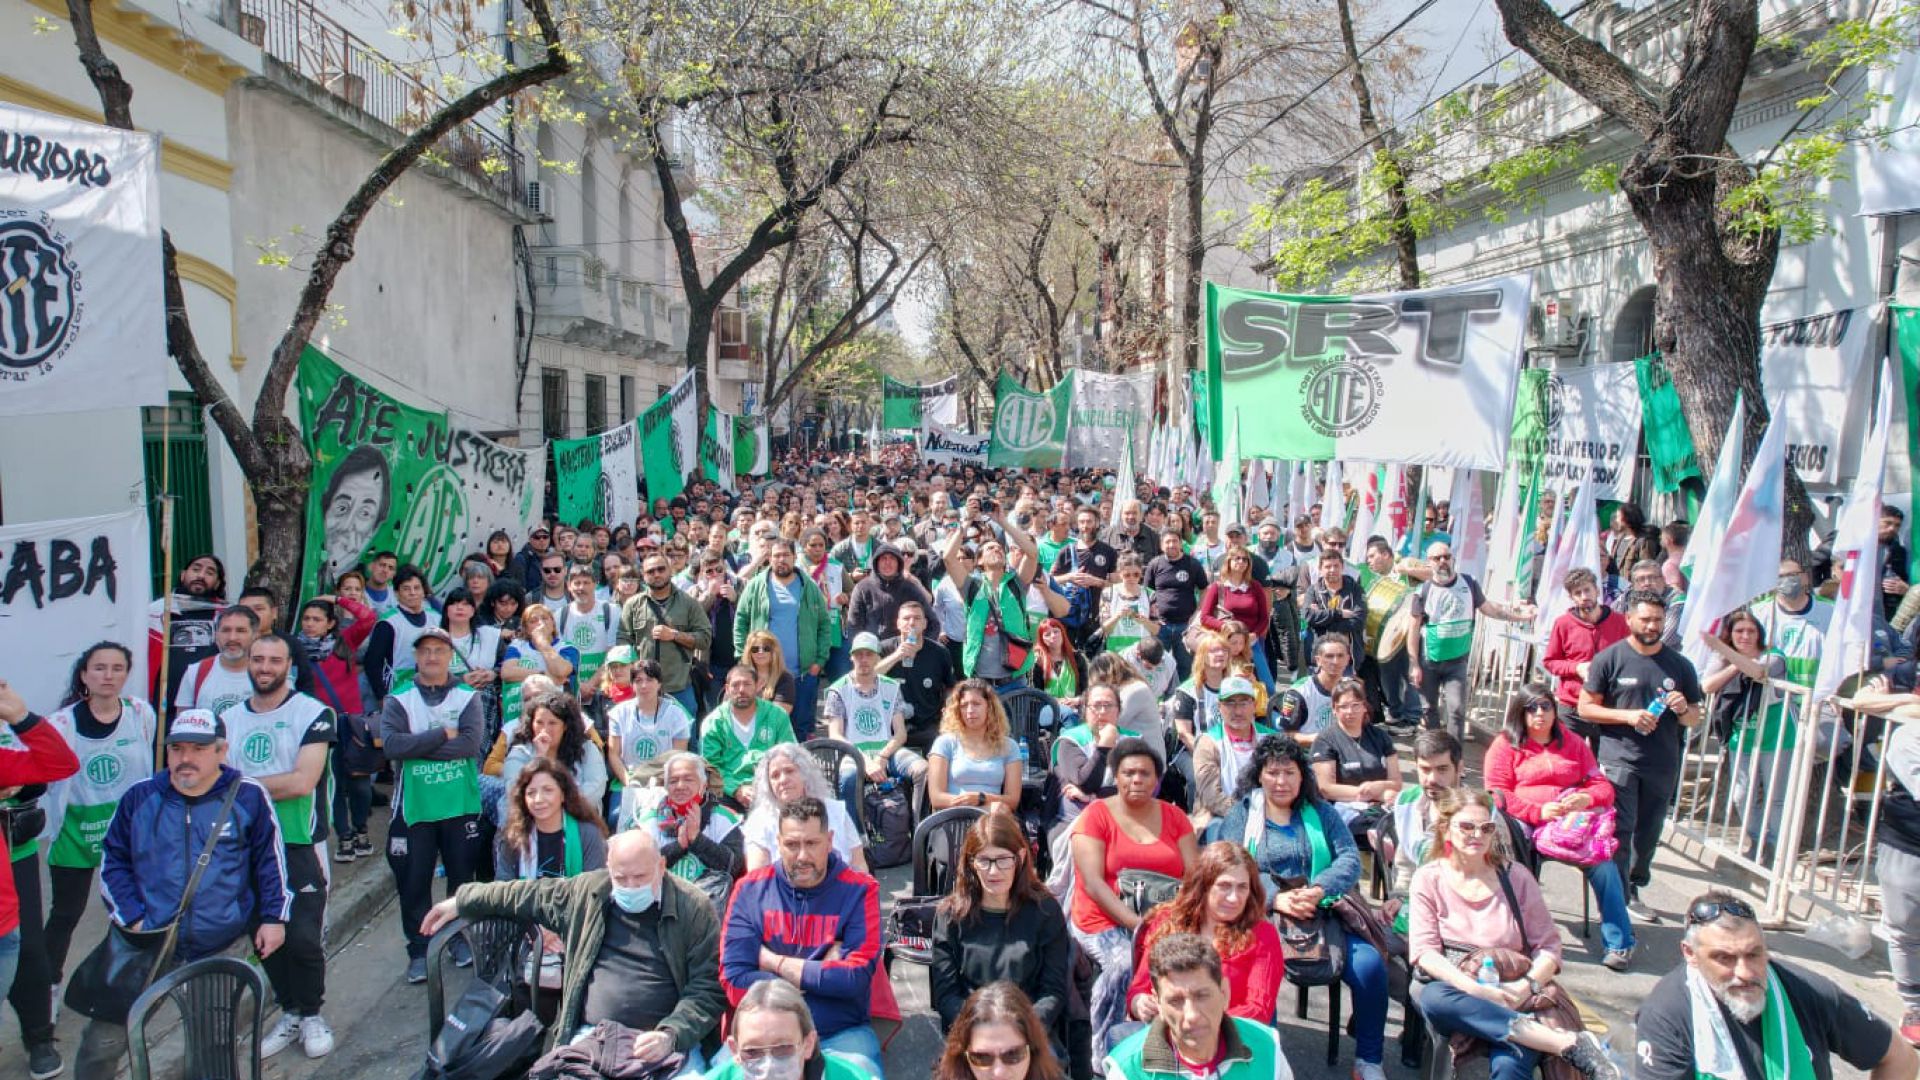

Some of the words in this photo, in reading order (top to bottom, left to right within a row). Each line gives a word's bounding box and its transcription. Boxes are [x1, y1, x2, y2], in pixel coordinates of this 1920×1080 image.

[1222, 288, 1503, 376] SRT
[1001, 398, 1051, 447] ATE
[1312, 370, 1367, 423] ATE
[313, 373, 400, 446] ATE
[417, 421, 526, 498] JUSTICIA
[0, 536, 117, 609] ABA
[88, 757, 120, 783] ATE
